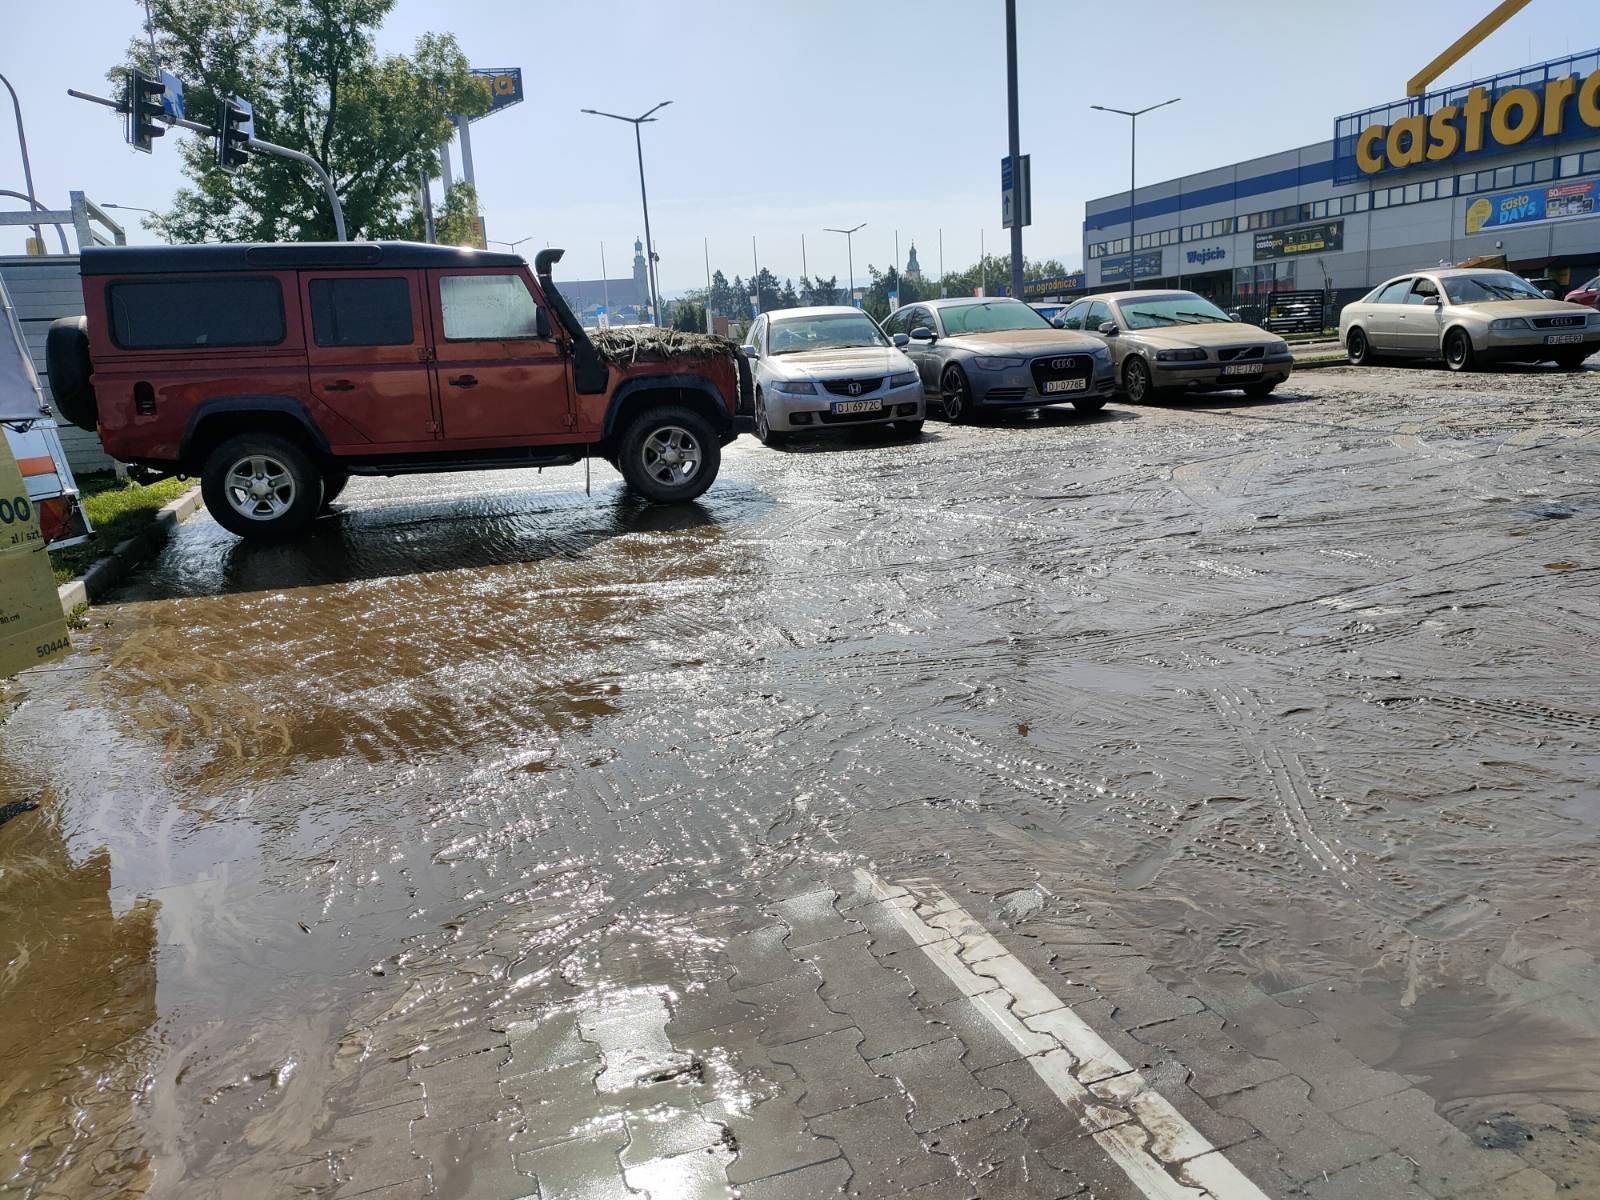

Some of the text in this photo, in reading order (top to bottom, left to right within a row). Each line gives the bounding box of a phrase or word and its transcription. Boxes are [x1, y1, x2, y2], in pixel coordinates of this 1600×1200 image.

[1500, 195, 1529, 212] casto
[1499, 201, 1537, 225] DAYS
[1186, 246, 1226, 265] Wejście
[1036, 278, 1077, 295] ogrodnicze
[1048, 382, 1058, 391] DJ
[837, 400, 880, 413] DJ 6972C
[36, 637, 70, 658] 50444
